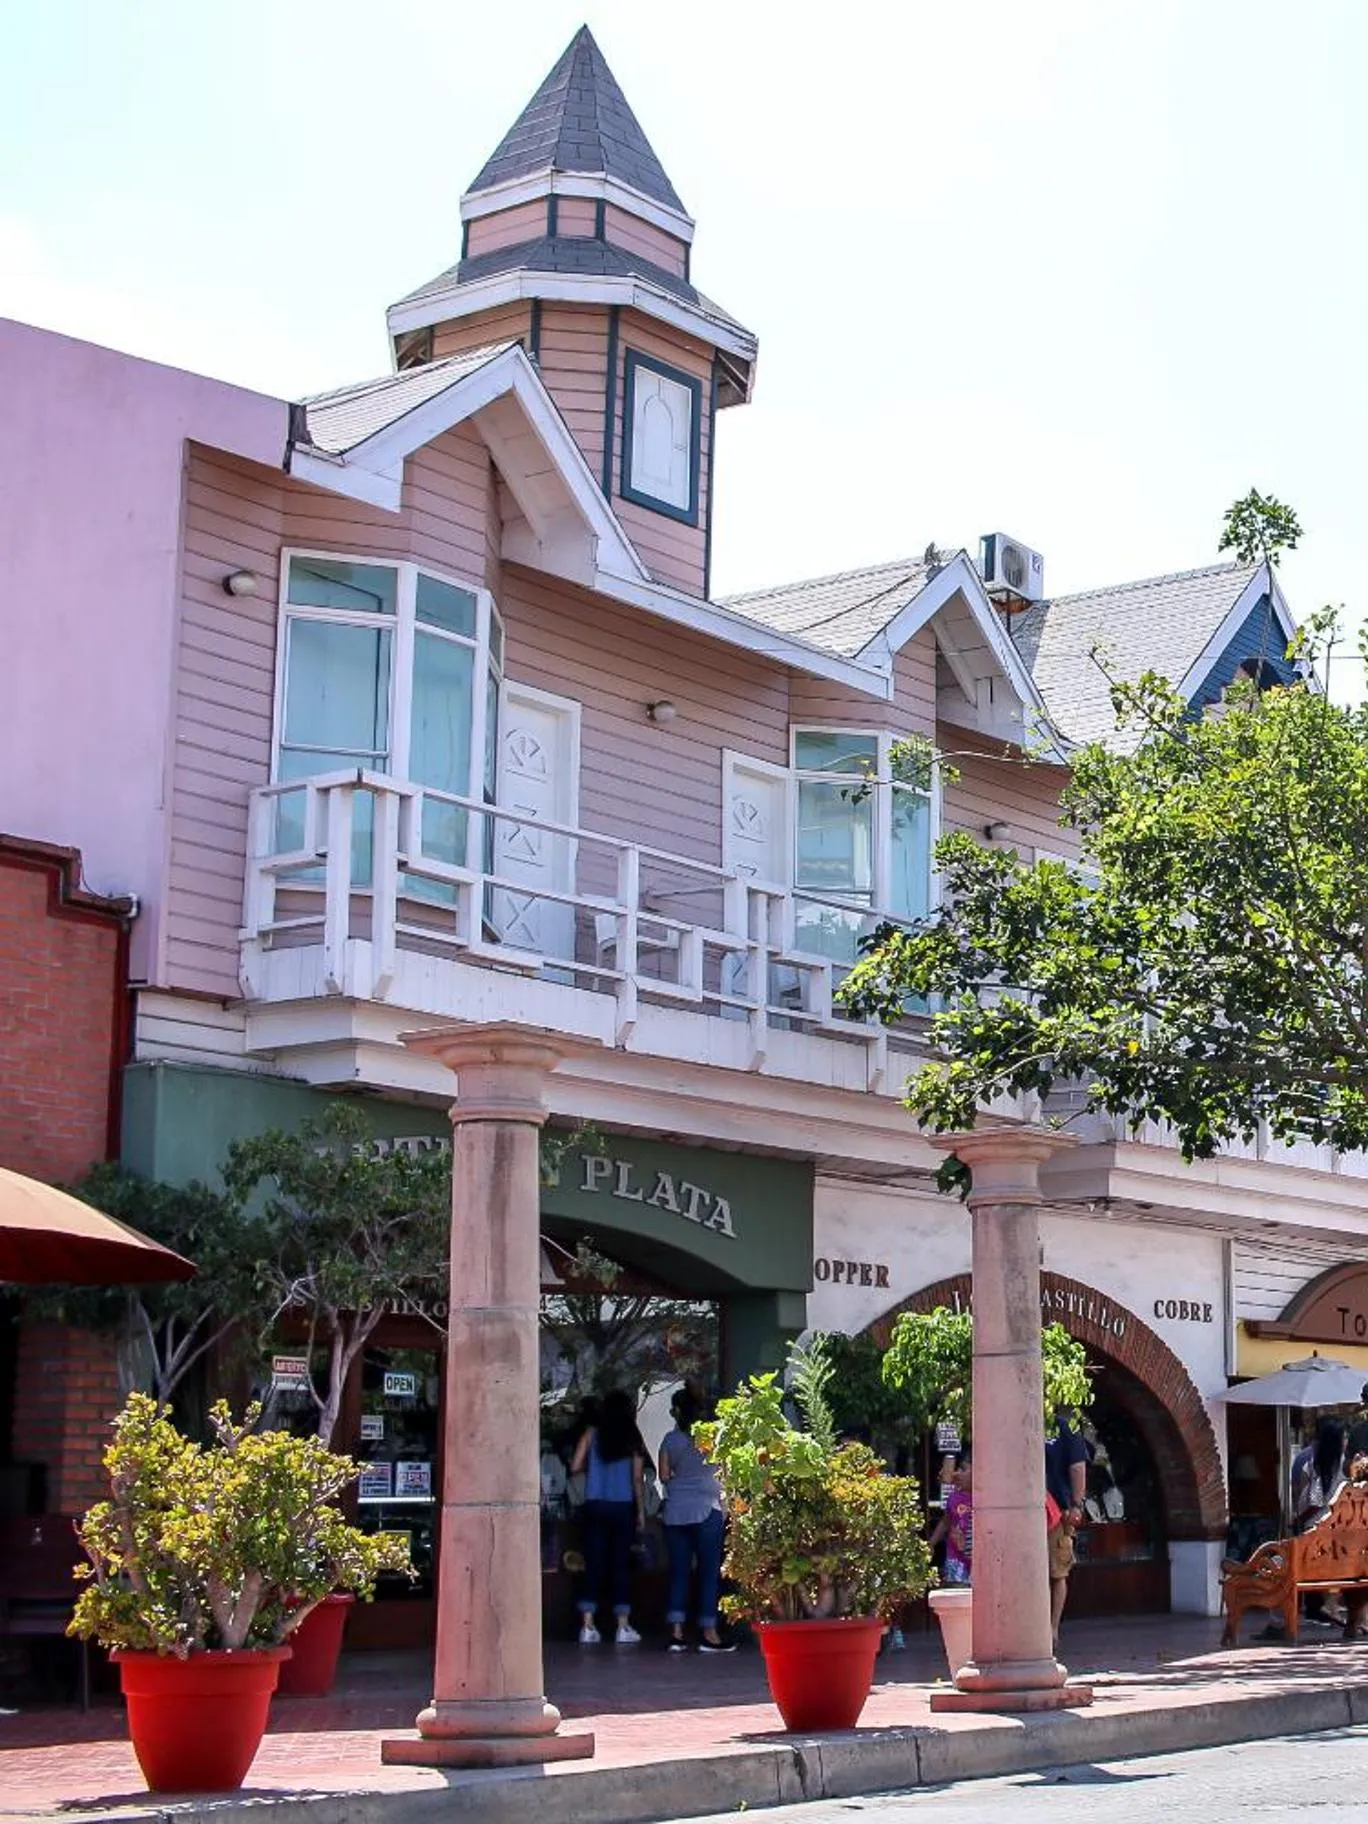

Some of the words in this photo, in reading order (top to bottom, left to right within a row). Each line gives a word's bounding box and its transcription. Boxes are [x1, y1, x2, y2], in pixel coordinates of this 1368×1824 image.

[579, 1154, 738, 1239] PLATA
[815, 1258, 890, 1289] OPPER
[1041, 1289, 1124, 1337] ASTILLO
[1153, 1299, 1213, 1324] COBRE
[386, 1375, 413, 1391] OPEN
